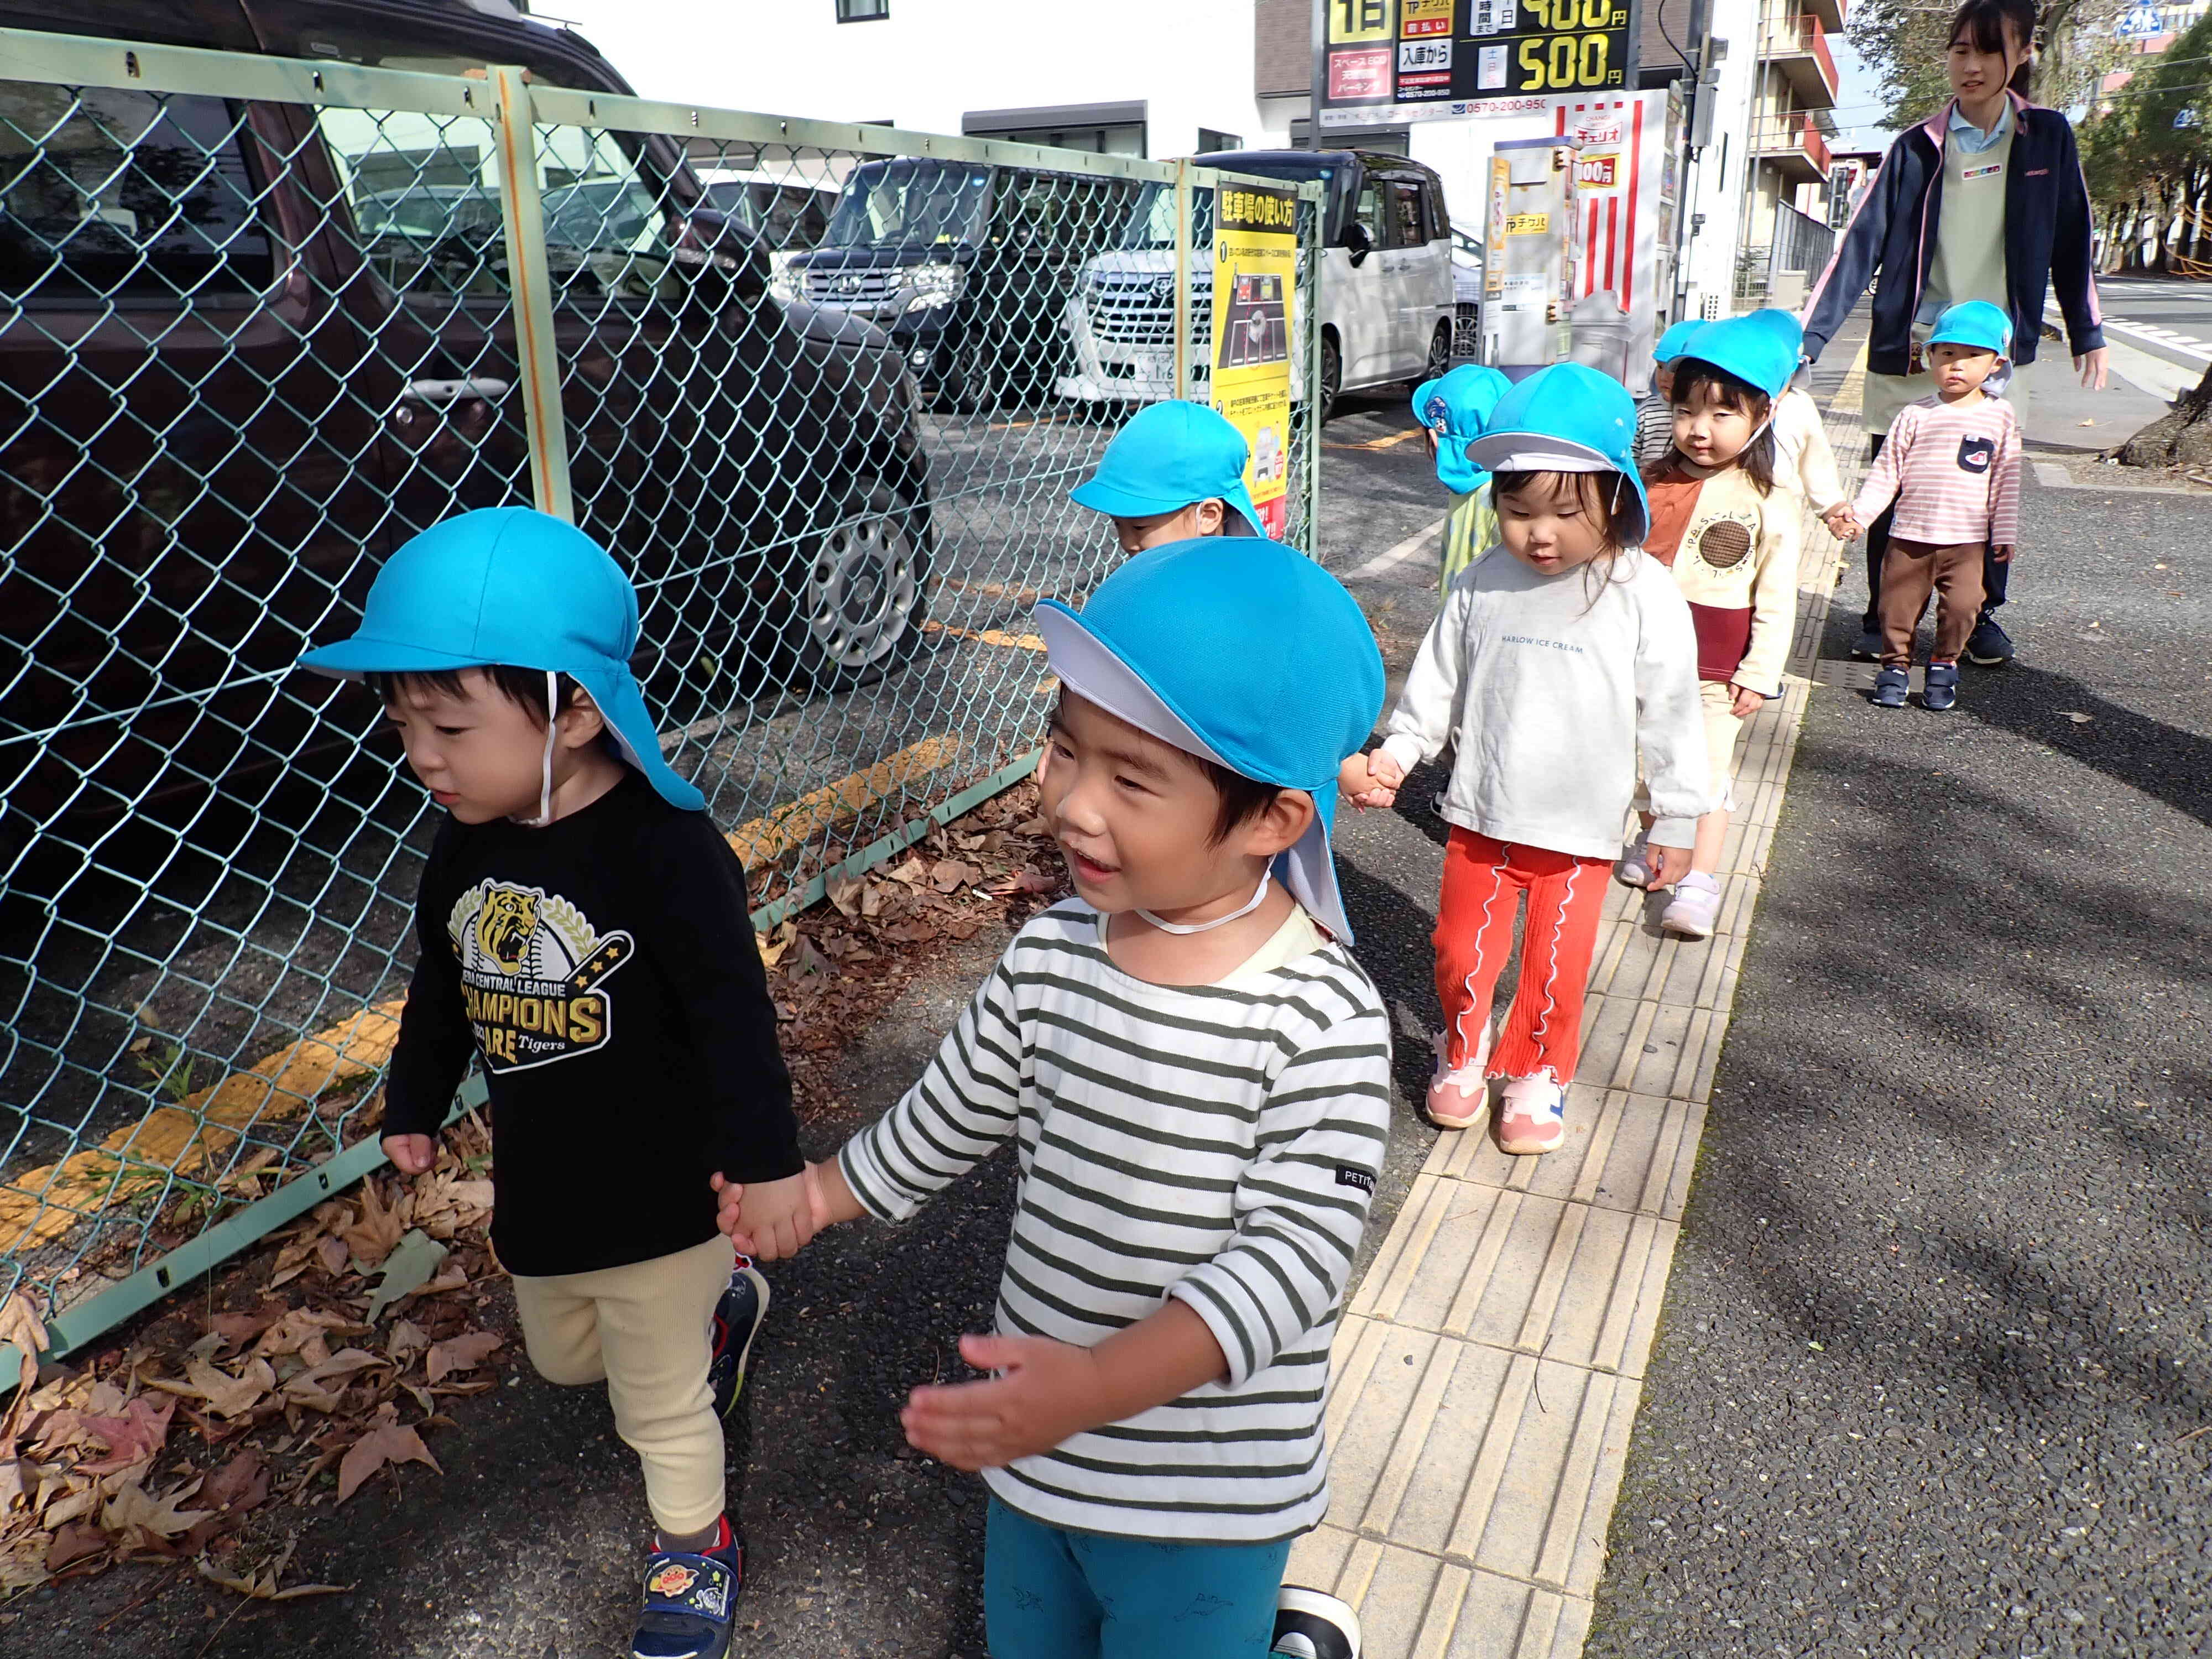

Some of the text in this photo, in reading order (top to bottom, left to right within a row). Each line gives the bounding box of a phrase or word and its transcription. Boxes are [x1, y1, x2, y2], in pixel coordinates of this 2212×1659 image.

[1403, 45, 1448, 66] 入庫から
[1578, 129, 1619, 143] チェリオ
[1222, 191, 1293, 227] 駐車場の使い方
[1502, 635, 1533, 645] HARLOW
[1553, 641, 1583, 654] CREAM
[476, 973, 515, 992] CENTRAL
[517, 979, 566, 997] LEAGUE
[518, 1034, 566, 1053] Tigers
